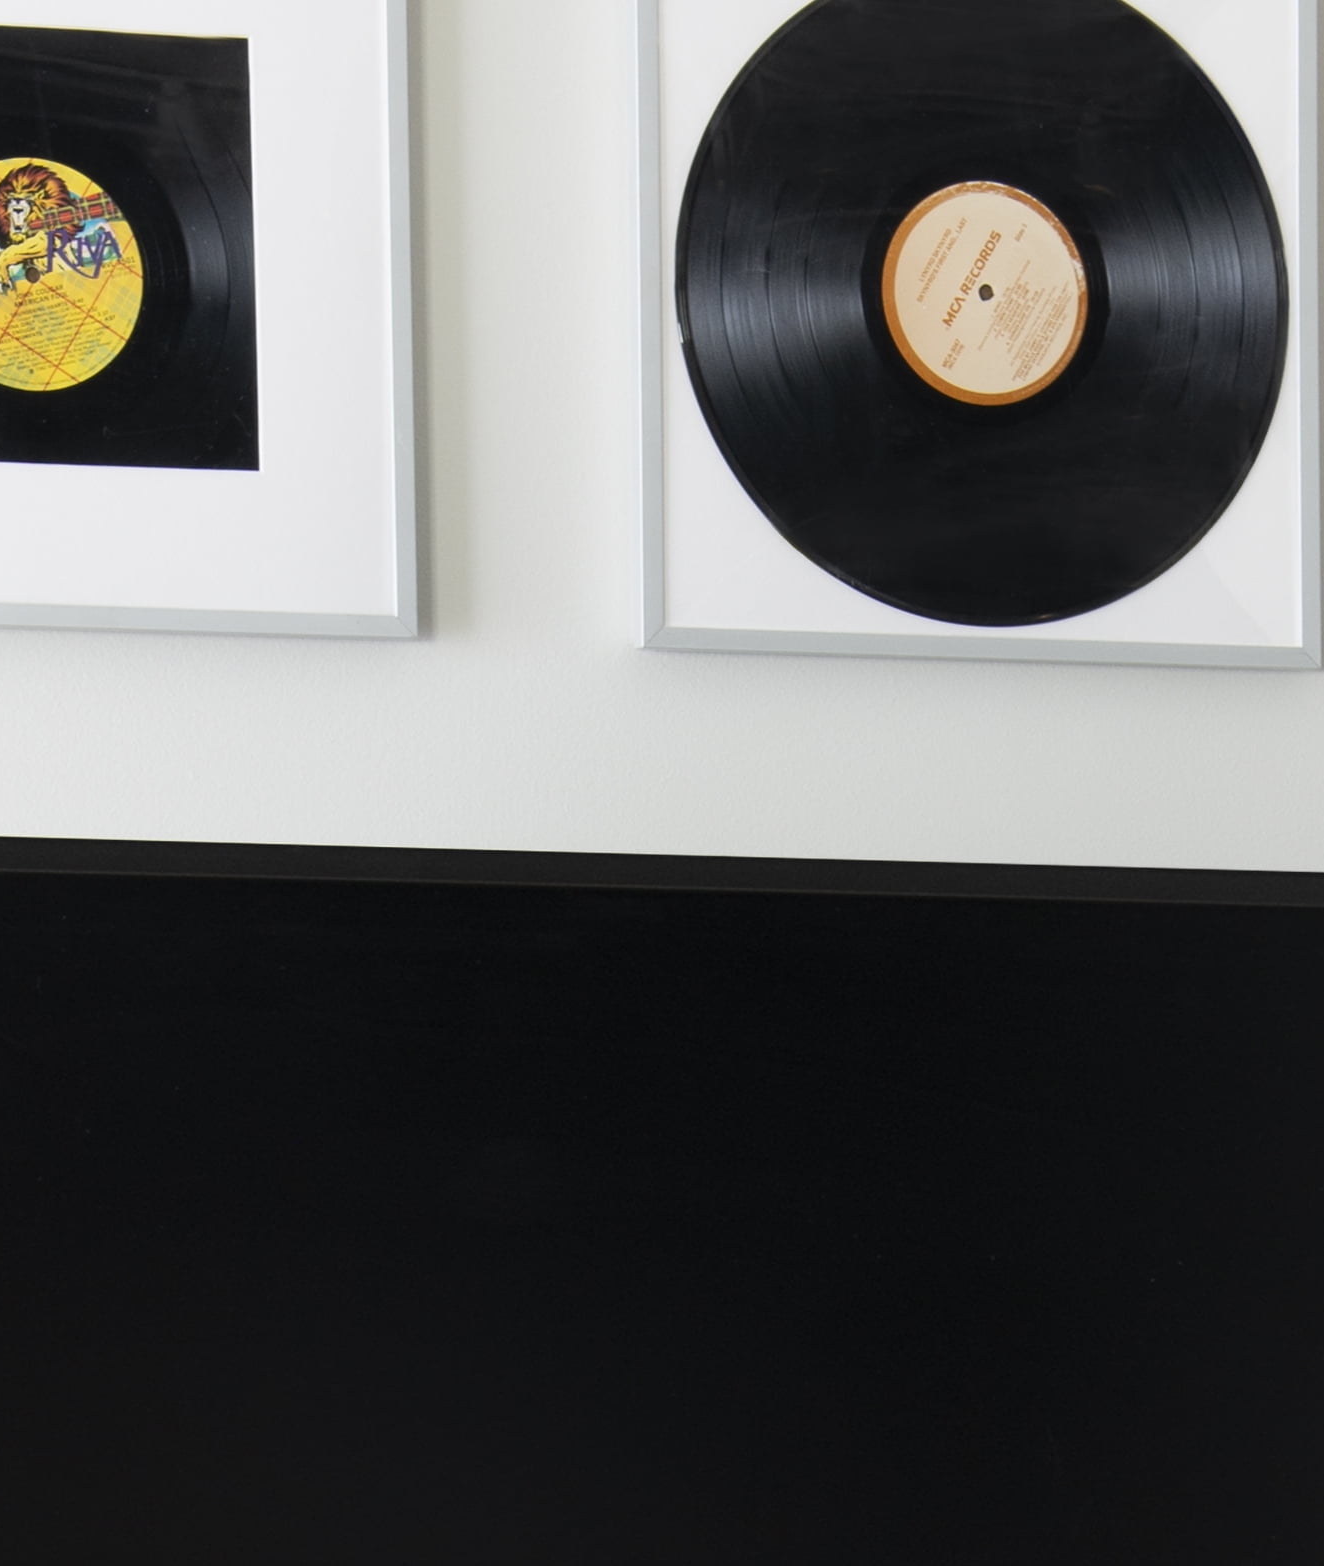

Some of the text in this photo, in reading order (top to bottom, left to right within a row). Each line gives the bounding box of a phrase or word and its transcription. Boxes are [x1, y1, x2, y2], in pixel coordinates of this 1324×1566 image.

[45, 230, 122, 279] RIVA
[942, 296, 966, 328] MCA
[960, 230, 1002, 296] RECORDS
